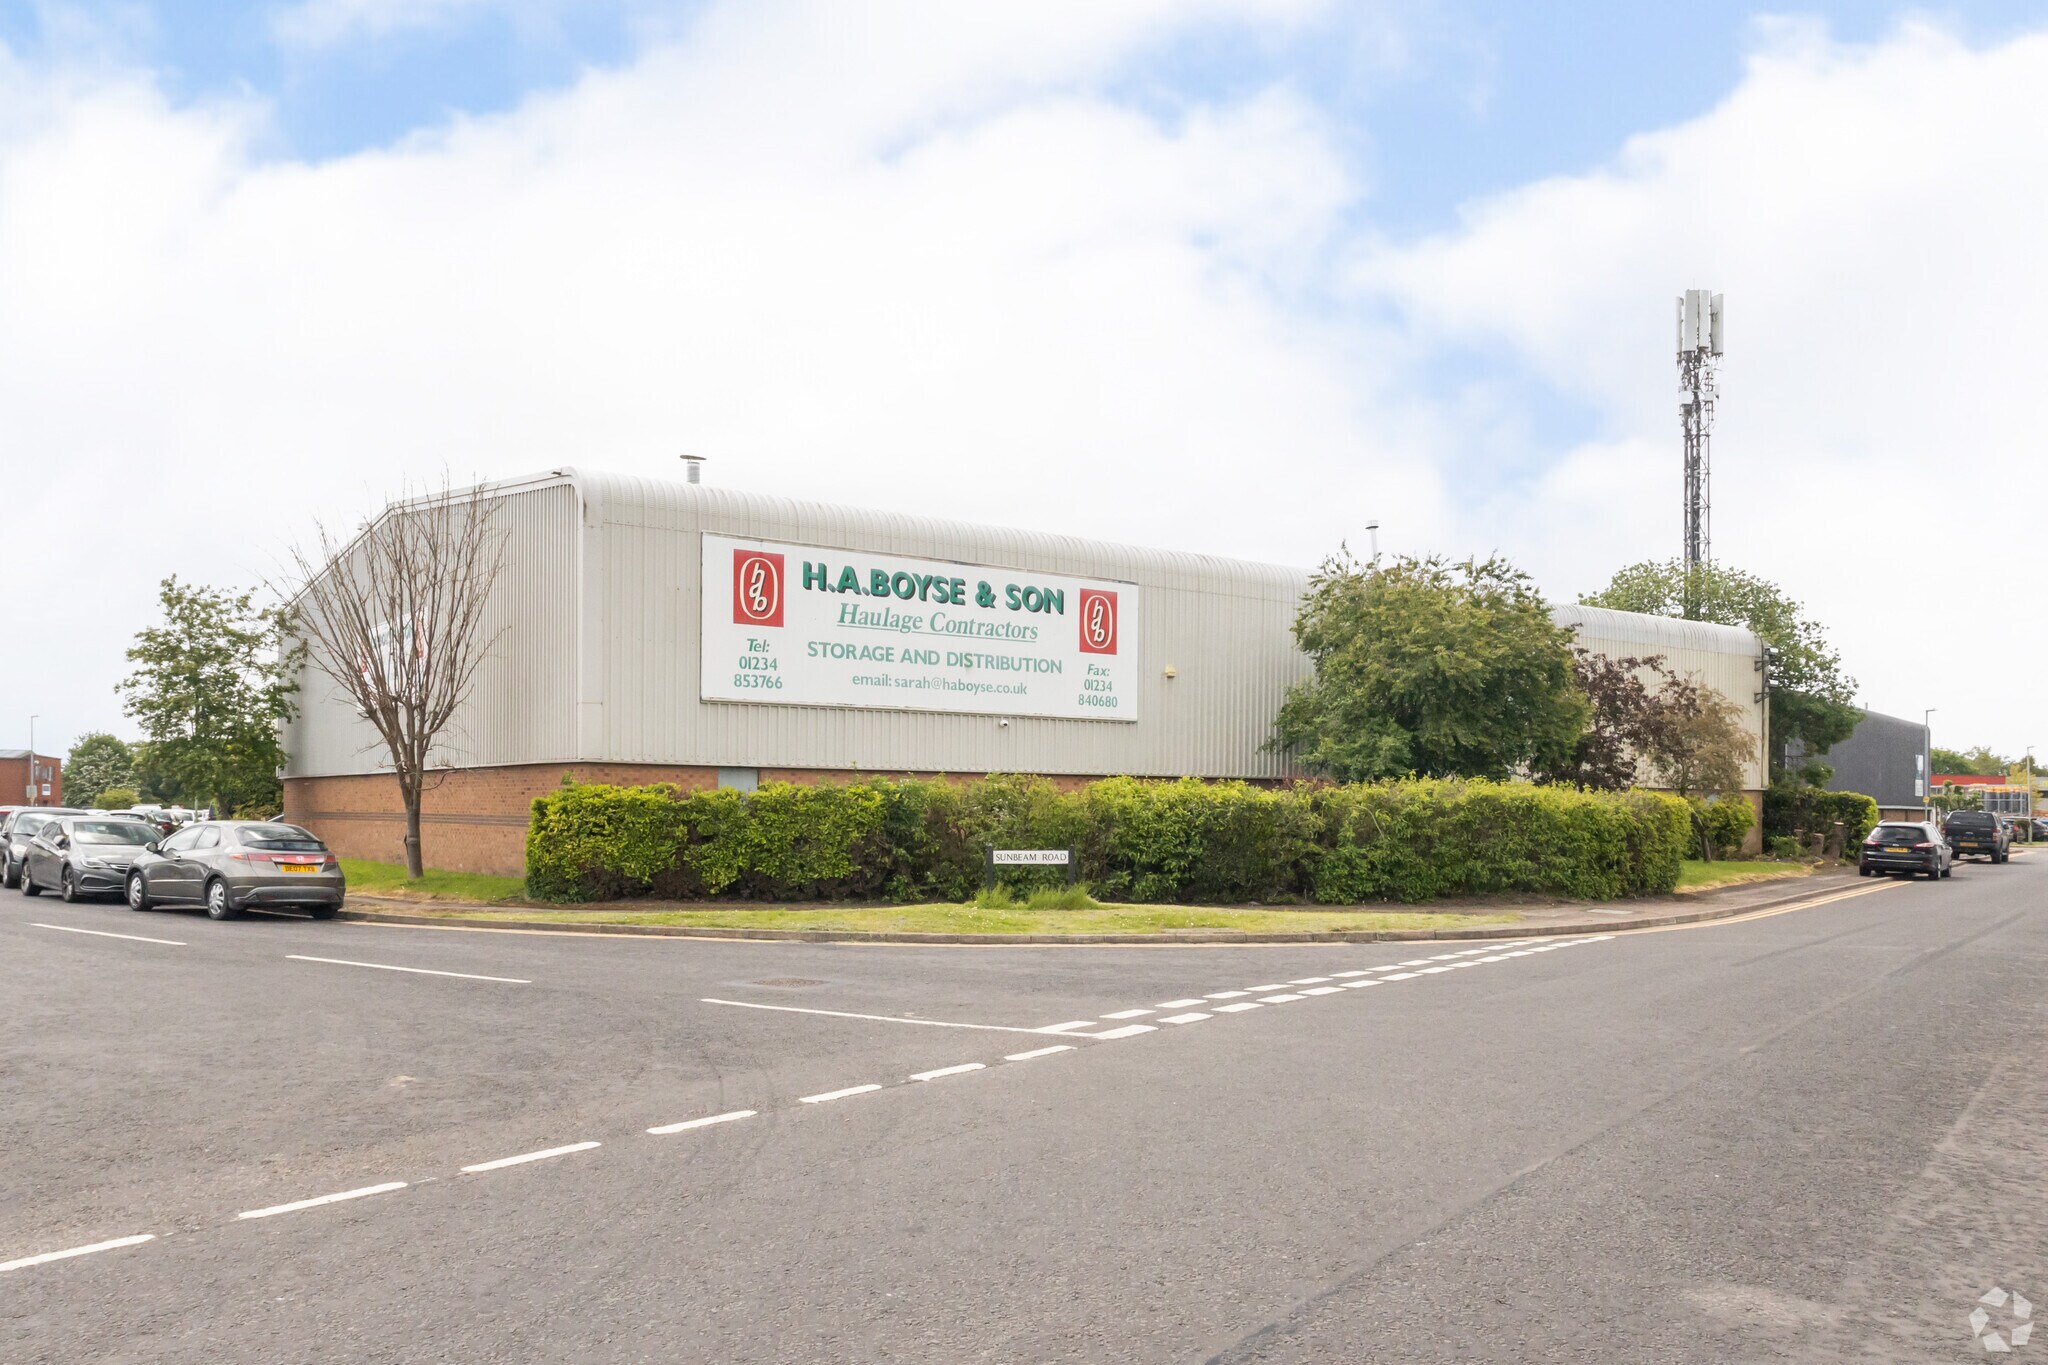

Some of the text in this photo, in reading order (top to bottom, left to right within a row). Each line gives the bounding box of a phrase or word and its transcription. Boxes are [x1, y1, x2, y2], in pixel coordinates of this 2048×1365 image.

[803, 561, 1065, 616] H.A.BOYSE & SON
[838, 603, 1039, 640] Haulage Contractors
[747, 638, 770, 653] Tel:
[739, 656, 778, 671] 01234
[807, 641, 1062, 675] STORAGE AND DISTRIBUTION
[1087, 663, 1110, 677] Fax:
[733, 674, 783, 690] 853766
[852, 674, 1027, 696] email: sarah@haboyse.co.uk
[1083, 679, 1113, 693] 01234
[1077, 694, 1118, 709] 840680
[995, 853, 1067, 861] SUNBEAM ROAD
